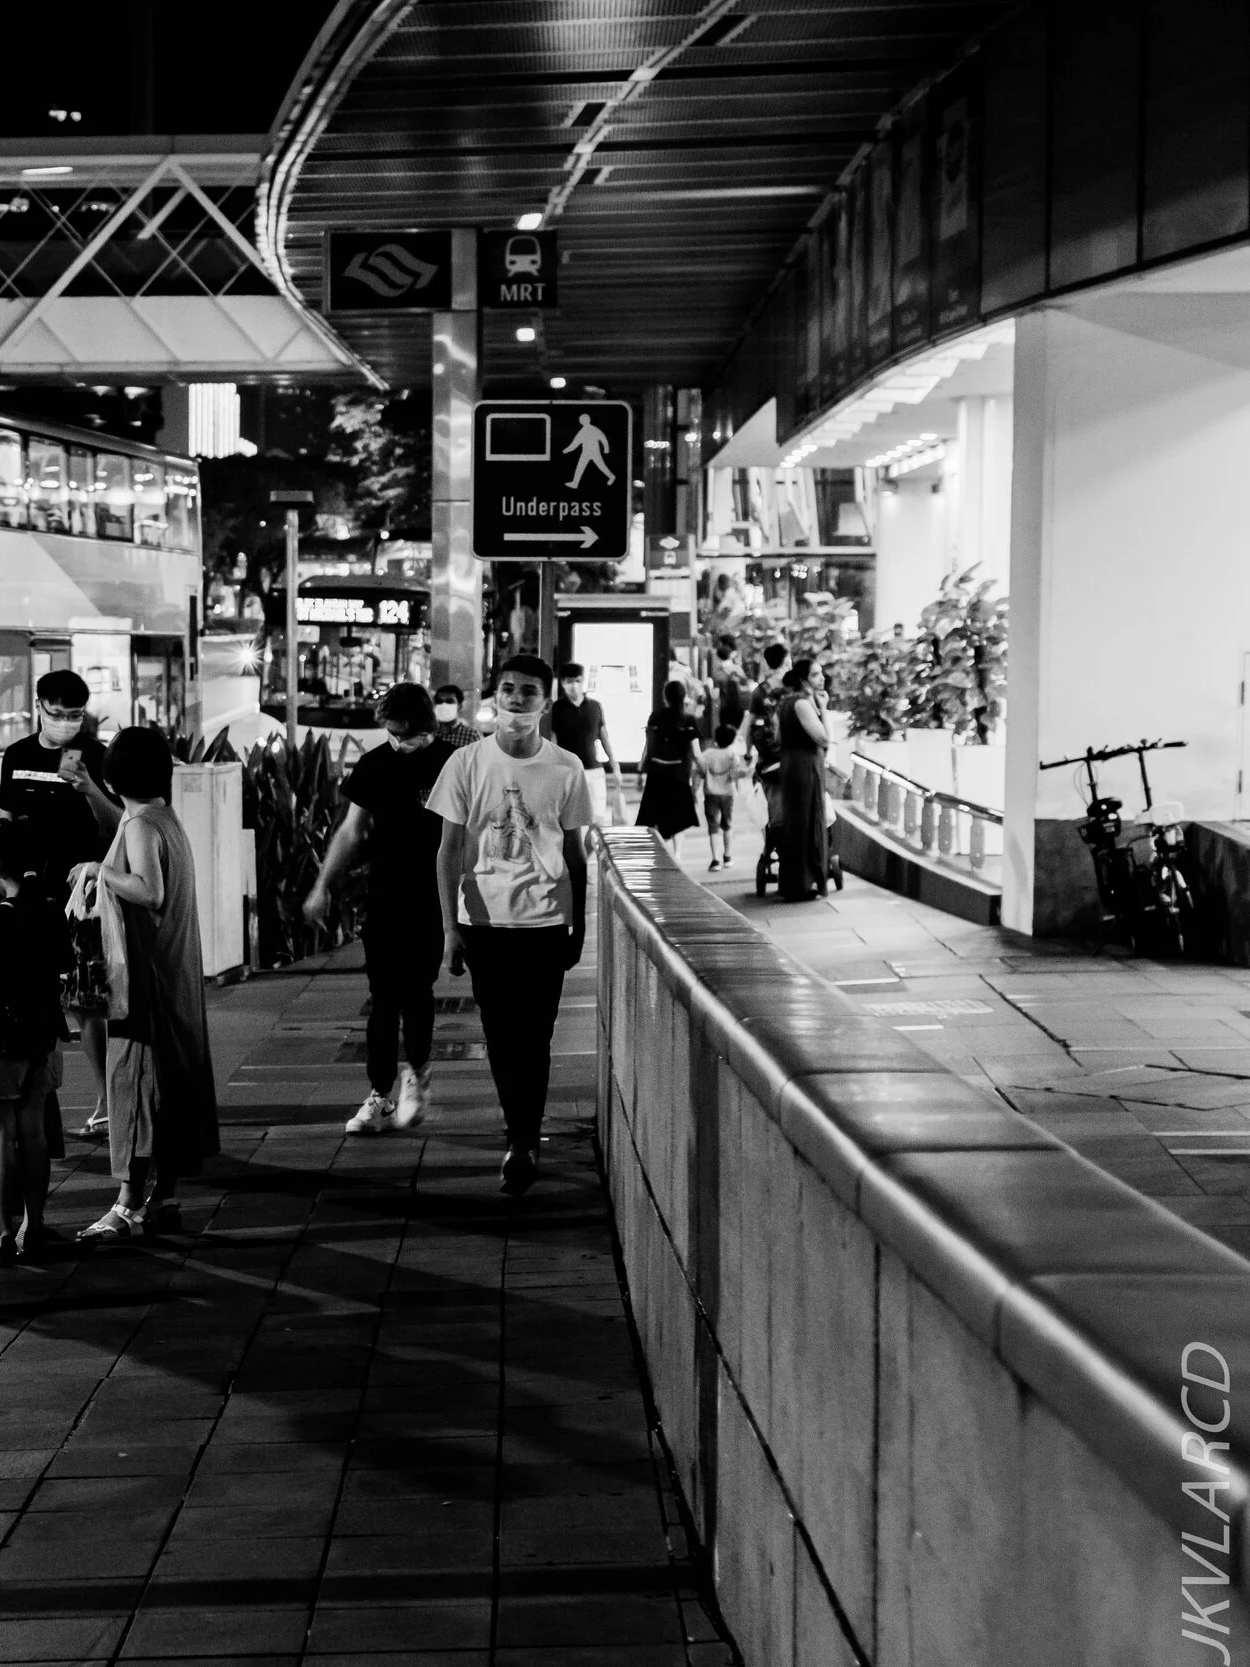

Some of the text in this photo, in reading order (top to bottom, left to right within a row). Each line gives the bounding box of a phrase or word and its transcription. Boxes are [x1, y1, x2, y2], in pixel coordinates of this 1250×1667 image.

[500, 283, 546, 302] MRT
[502, 496, 602, 521] Underpass
[378, 600, 409, 624] 124
